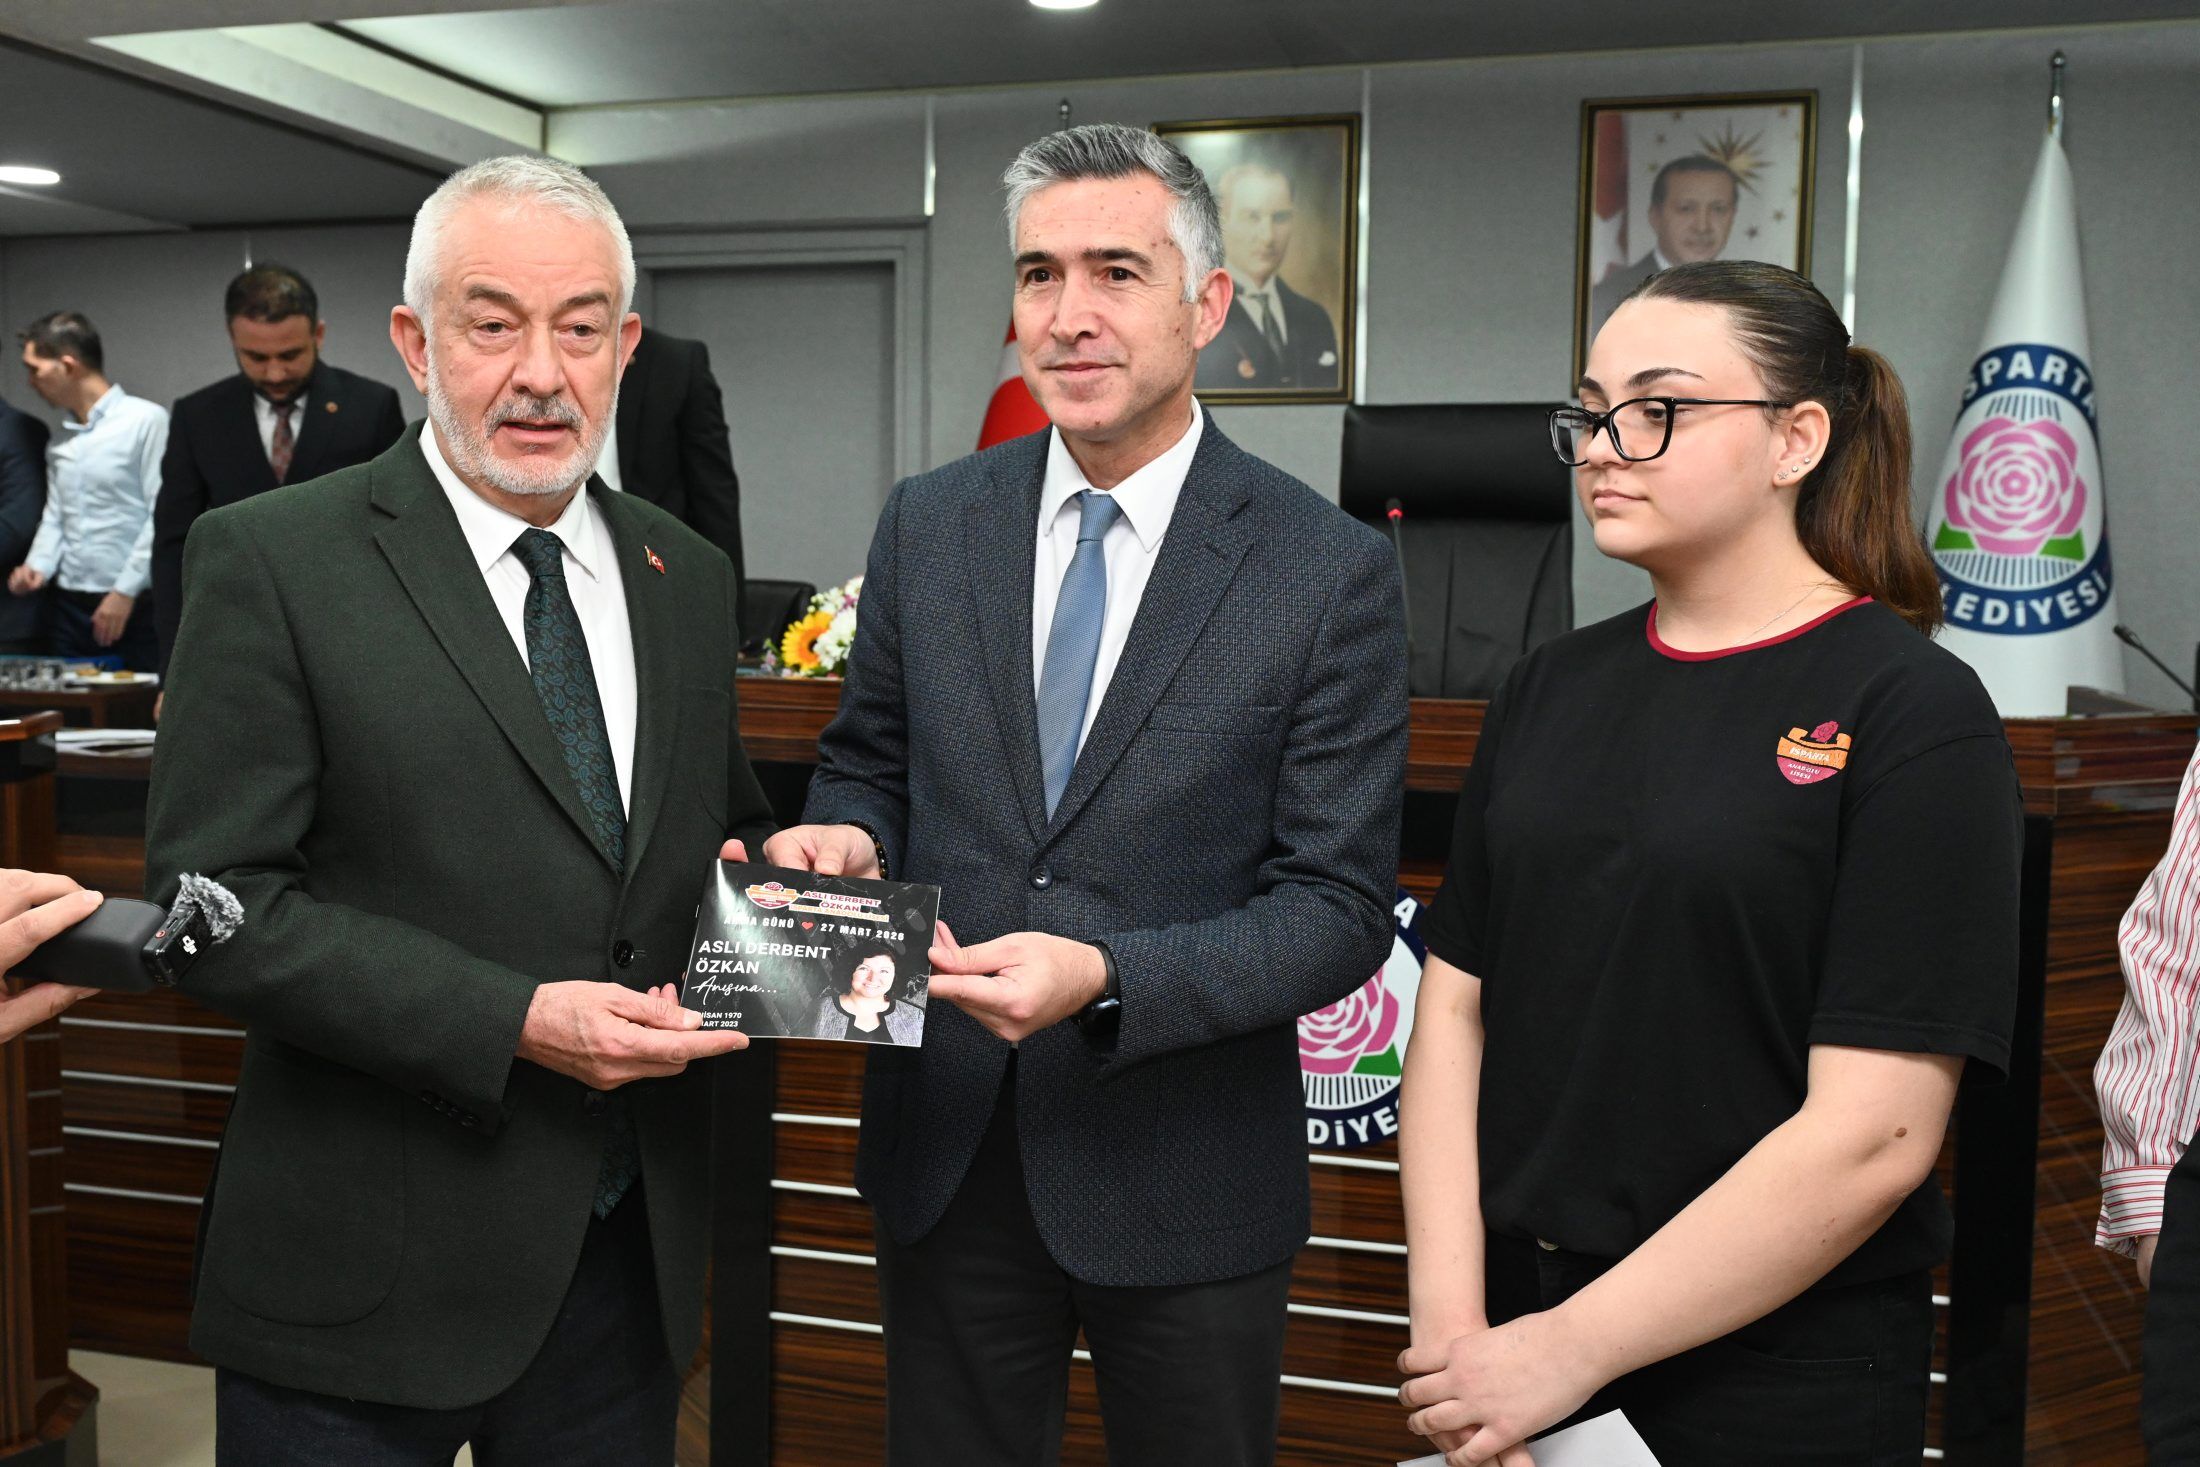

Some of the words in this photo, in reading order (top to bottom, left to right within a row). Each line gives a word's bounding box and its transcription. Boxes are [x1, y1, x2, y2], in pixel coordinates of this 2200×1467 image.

[803, 891, 827, 901] ASLI
[830, 894, 880, 907] DERBENT
[820, 901, 860, 912] ÖZKAN
[762, 916, 794, 929] GÜNÜ
[820, 923, 835, 933] 27
[839, 925, 872, 937] MART
[876, 929, 904, 941] 2026
[698, 940, 740, 954] ASLI
[745, 942, 831, 959] DERBENT
[695, 957, 759, 974] ÖZKAN
[701, 1020, 720, 1028] ART
[720, 1020, 739, 1028] 2023
